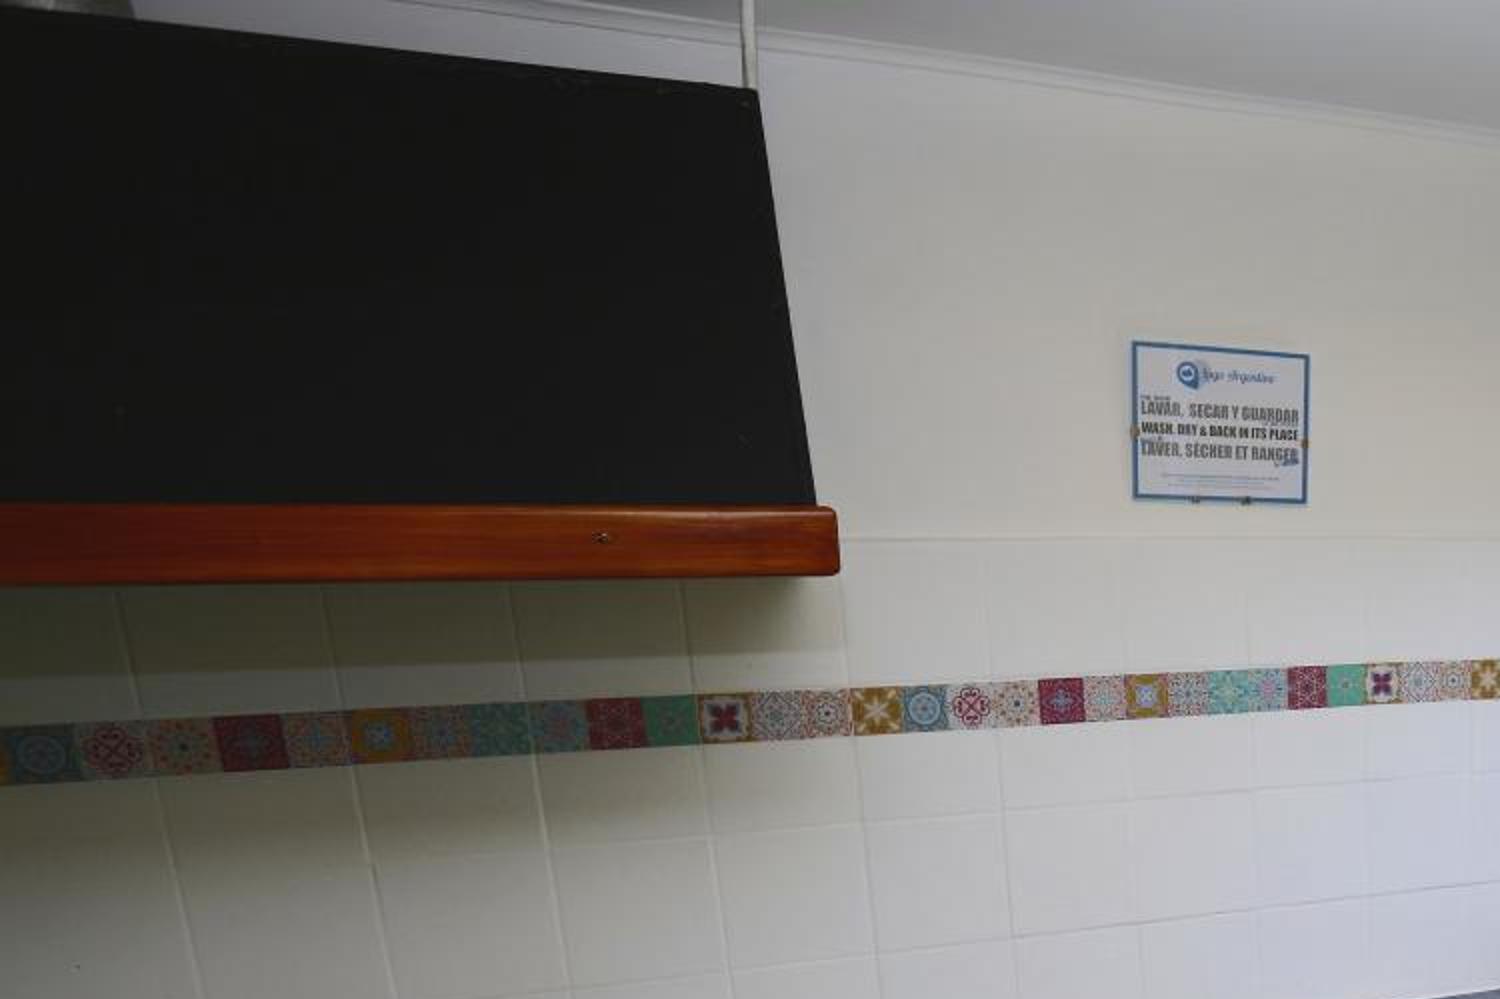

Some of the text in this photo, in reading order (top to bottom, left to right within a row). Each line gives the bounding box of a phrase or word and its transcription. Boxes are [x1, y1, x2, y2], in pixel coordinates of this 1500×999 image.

[1189, 403, 1229, 420] SECAR
[1231, 405, 1239, 419] Y
[1241, 406, 1299, 423] GUARDAR
[1177, 423, 1198, 437] DRY
[1199, 426, 1207, 437] &
[1209, 425, 1237, 439] BACK
[1239, 427, 1249, 439] IN
[1251, 427, 1267, 440] ITS
[1269, 428, 1299, 441] PLACE
[1235, 446, 1249, 460] ET
